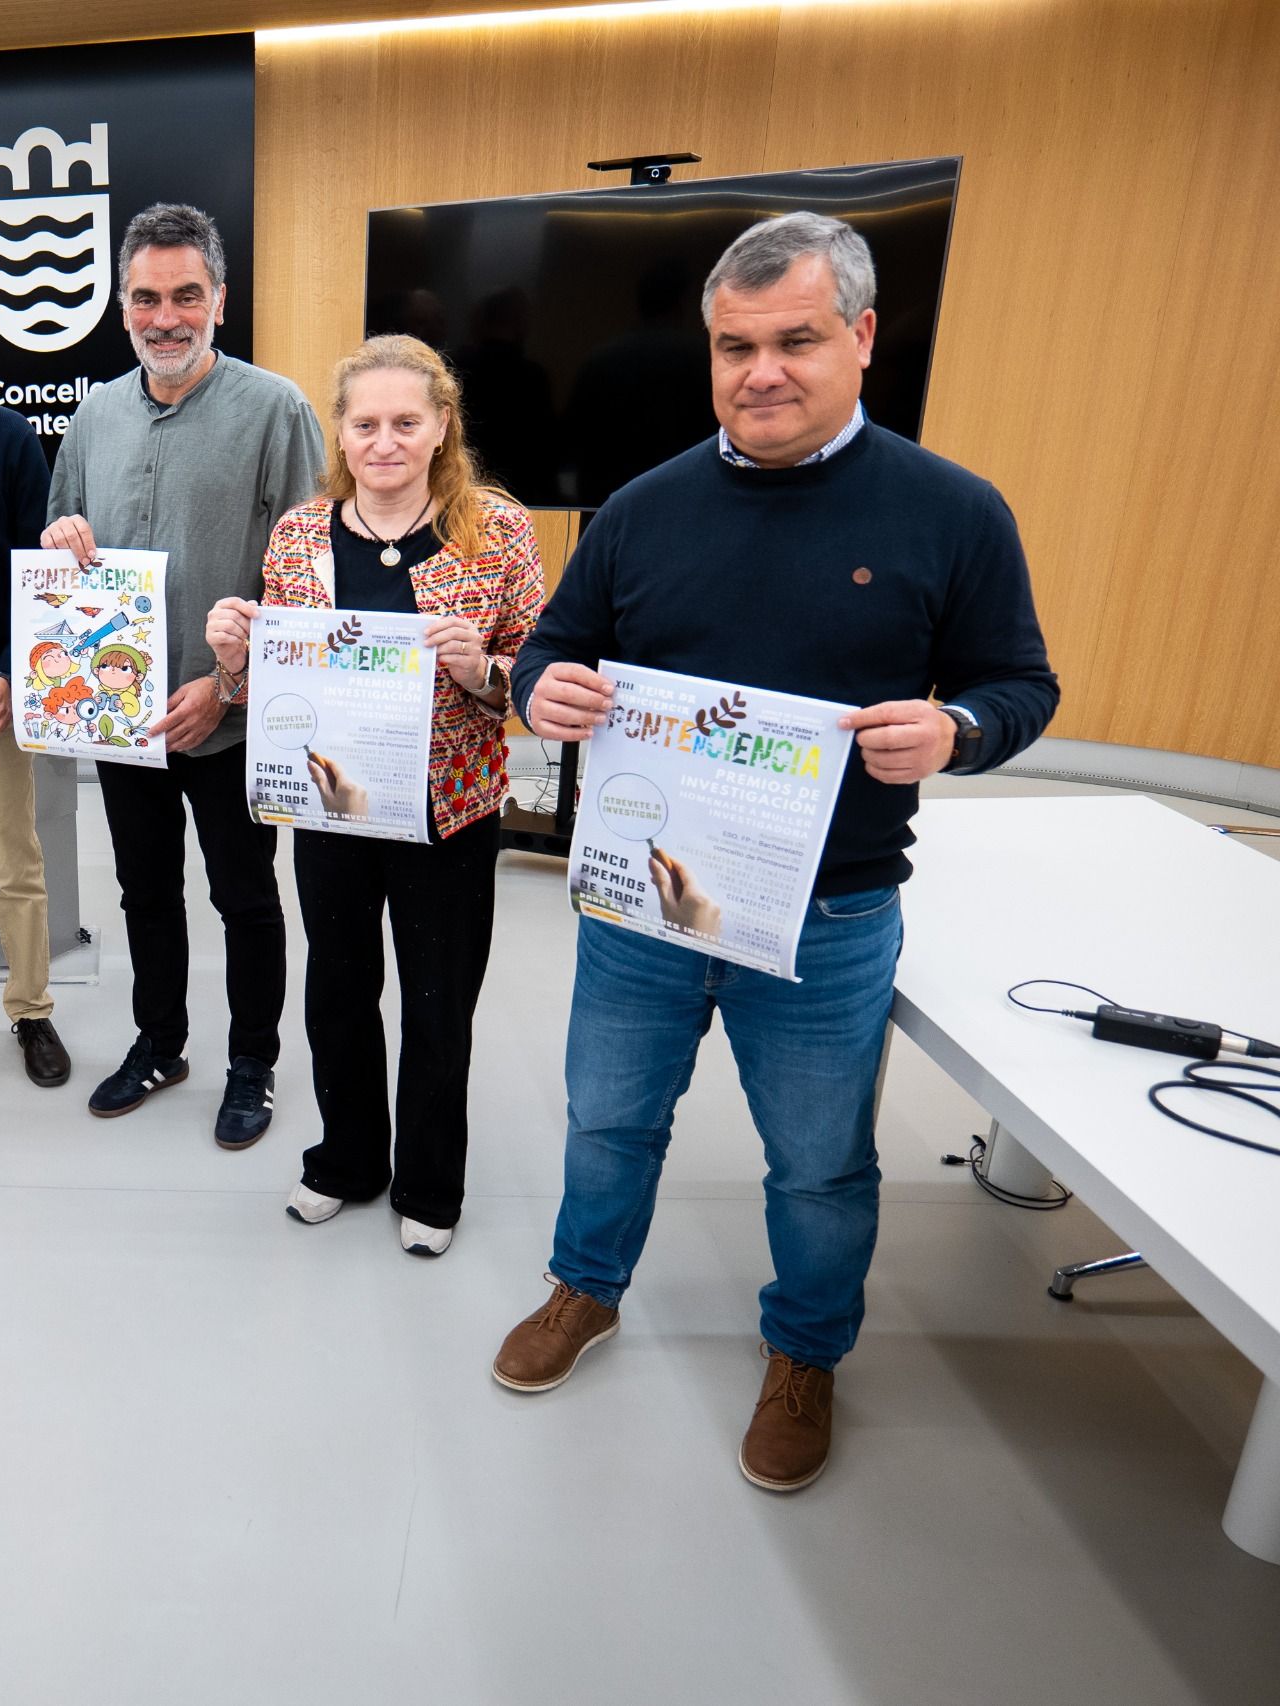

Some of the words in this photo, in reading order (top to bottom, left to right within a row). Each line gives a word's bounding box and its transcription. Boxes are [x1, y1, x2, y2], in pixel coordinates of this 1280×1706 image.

[616, 681, 634, 691] XIII
[256, 762, 292, 776] CINCO
[257, 778, 308, 793] PREMIOS
[715, 768, 792, 795] PREMIOS
[799, 787, 822, 802] DE
[257, 792, 270, 801] DE
[681, 775, 818, 817] INVESTIGACIÓN
[583, 846, 629, 870] CINCO
[582, 864, 647, 893] PREMIOS
[580, 880, 598, 893] DE
